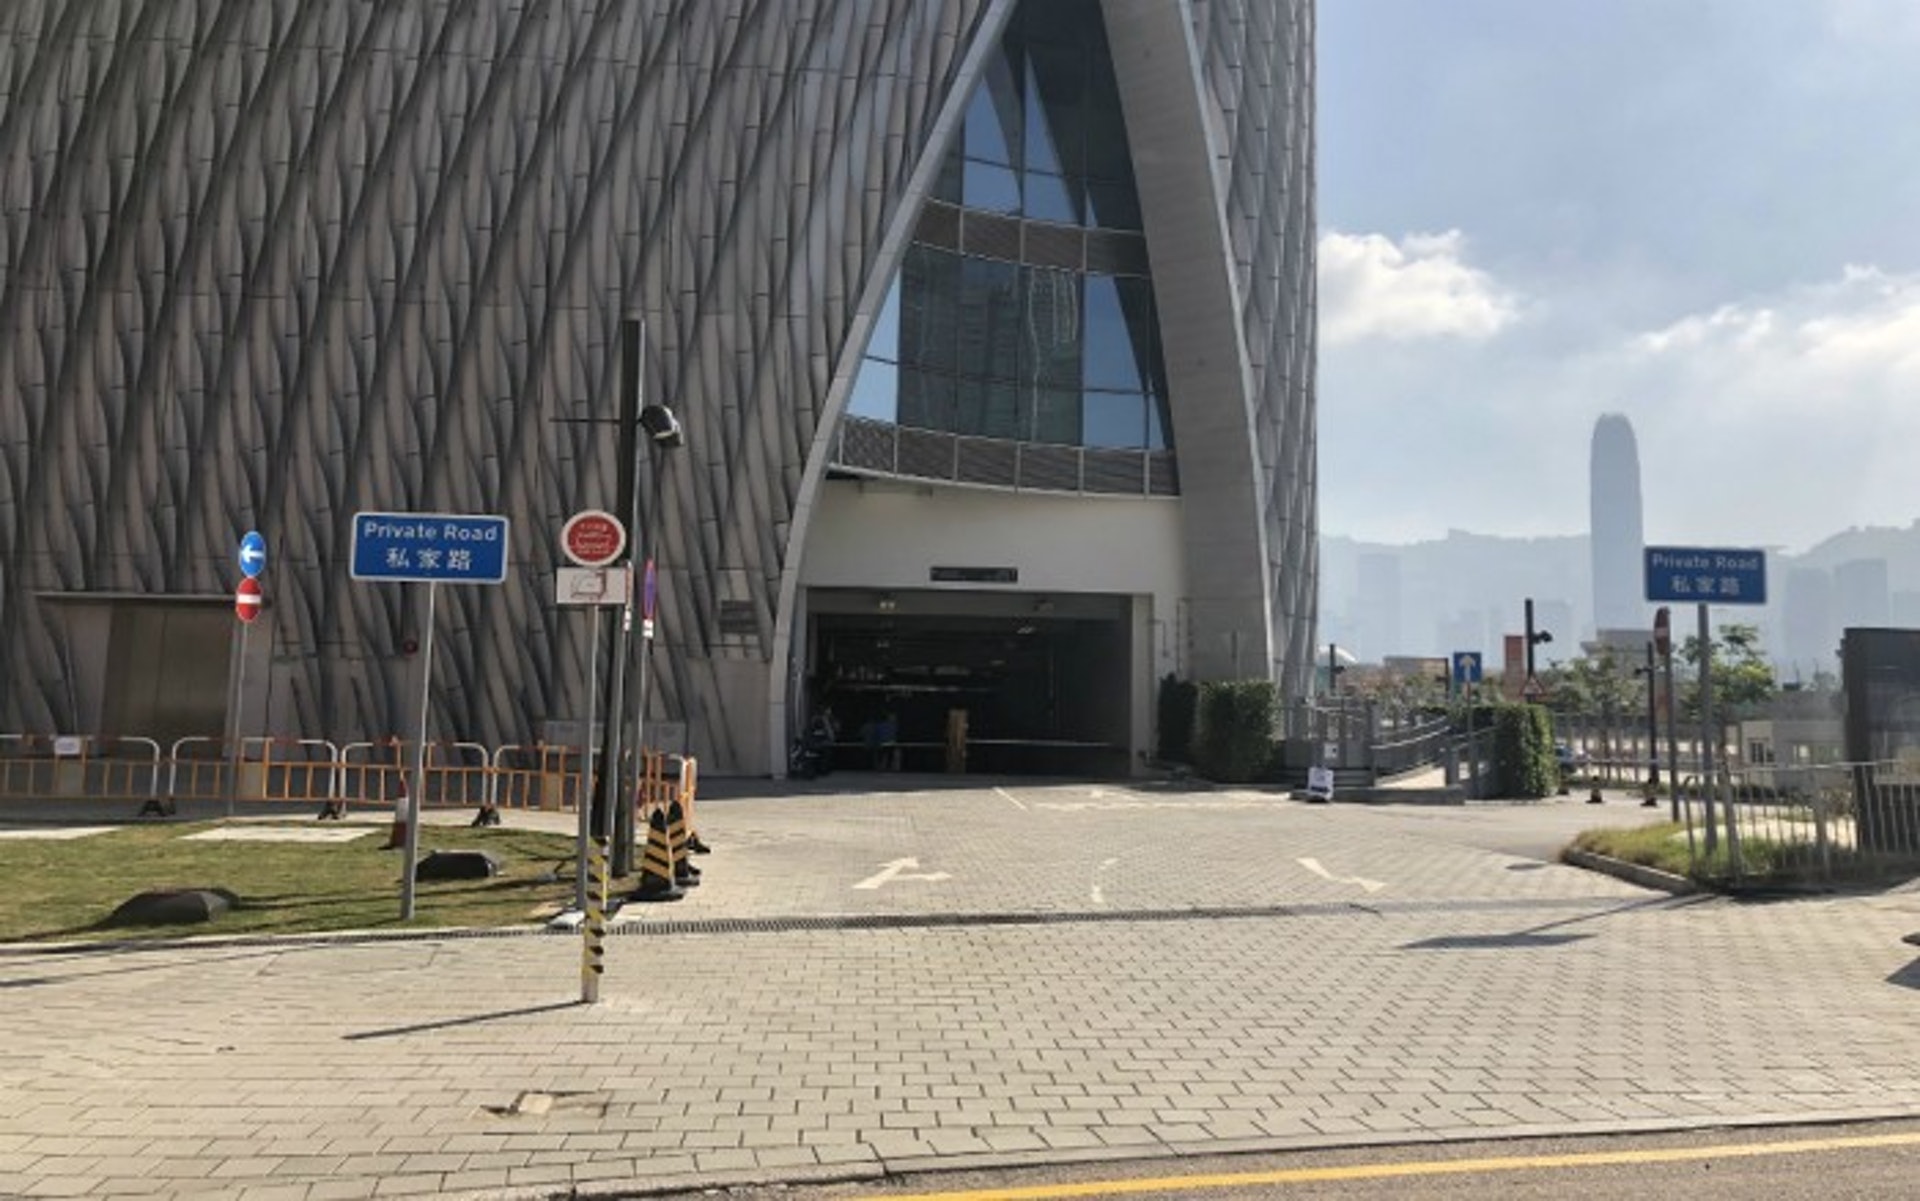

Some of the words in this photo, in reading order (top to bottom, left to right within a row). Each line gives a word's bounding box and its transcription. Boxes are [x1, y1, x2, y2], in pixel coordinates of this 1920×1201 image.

[363, 521, 437, 540] Private
[443, 523, 497, 541] Road
[386, 548, 472, 571] 私家路
[1652, 553, 1710, 568] Private
[1716, 556, 1759, 570] Road
